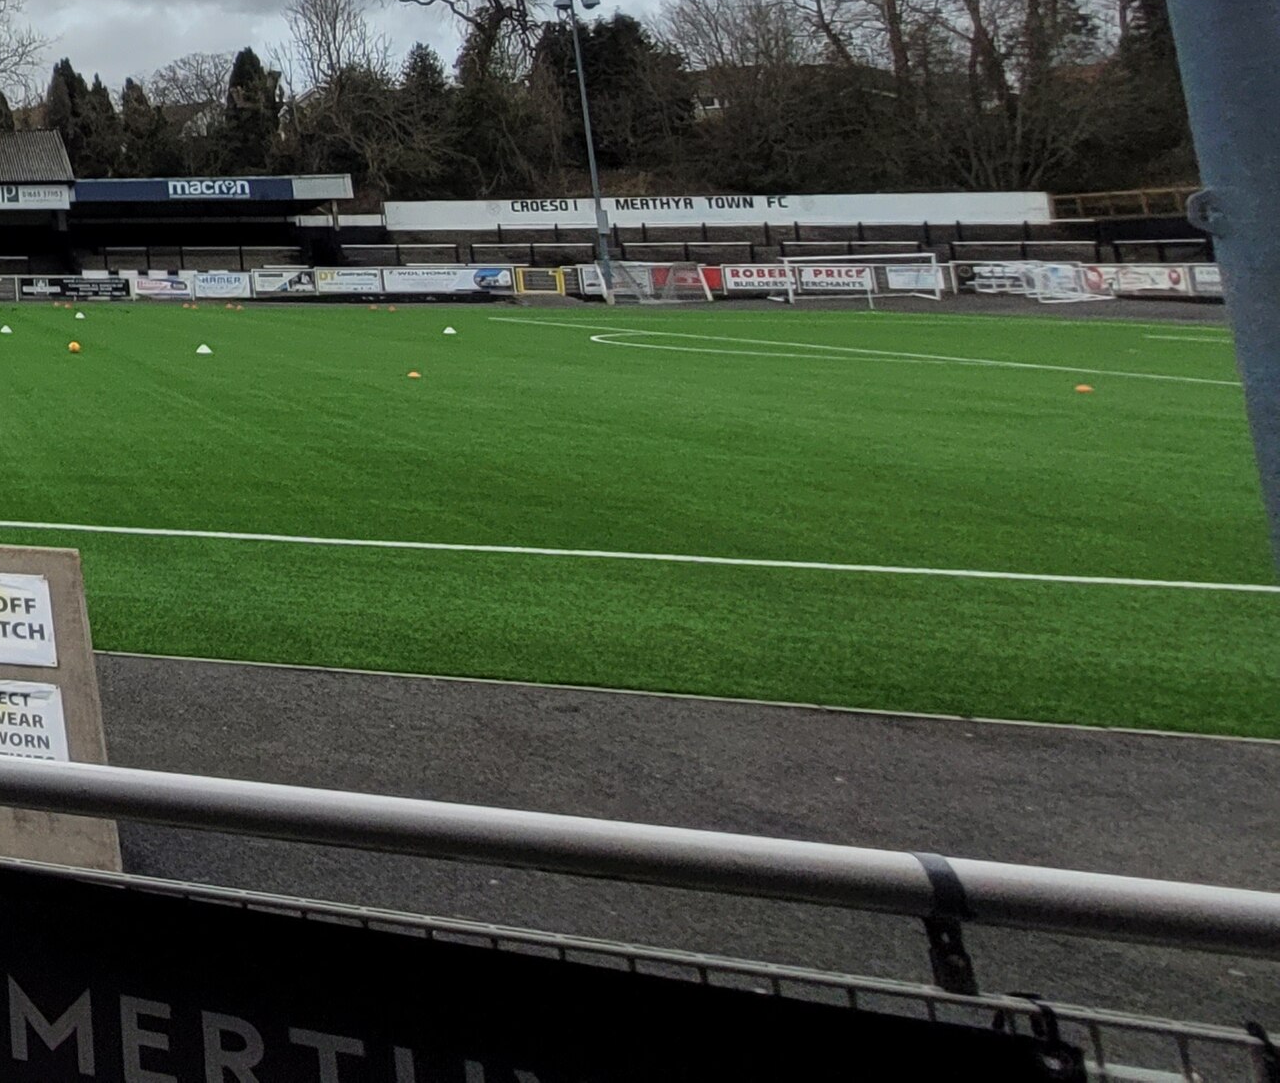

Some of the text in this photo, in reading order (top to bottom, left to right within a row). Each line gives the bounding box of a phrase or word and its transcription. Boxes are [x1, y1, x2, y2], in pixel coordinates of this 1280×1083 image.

[168, 180, 251, 196] macron
[511, 196, 789, 213] CROESO I MERTHYR TOWN FC
[319, 271, 336, 281] DT
[731, 268, 864, 278] ROBERT PRICE
[201, 276, 241, 285] HAMER
[7, 974, 540, 1083] MERT
